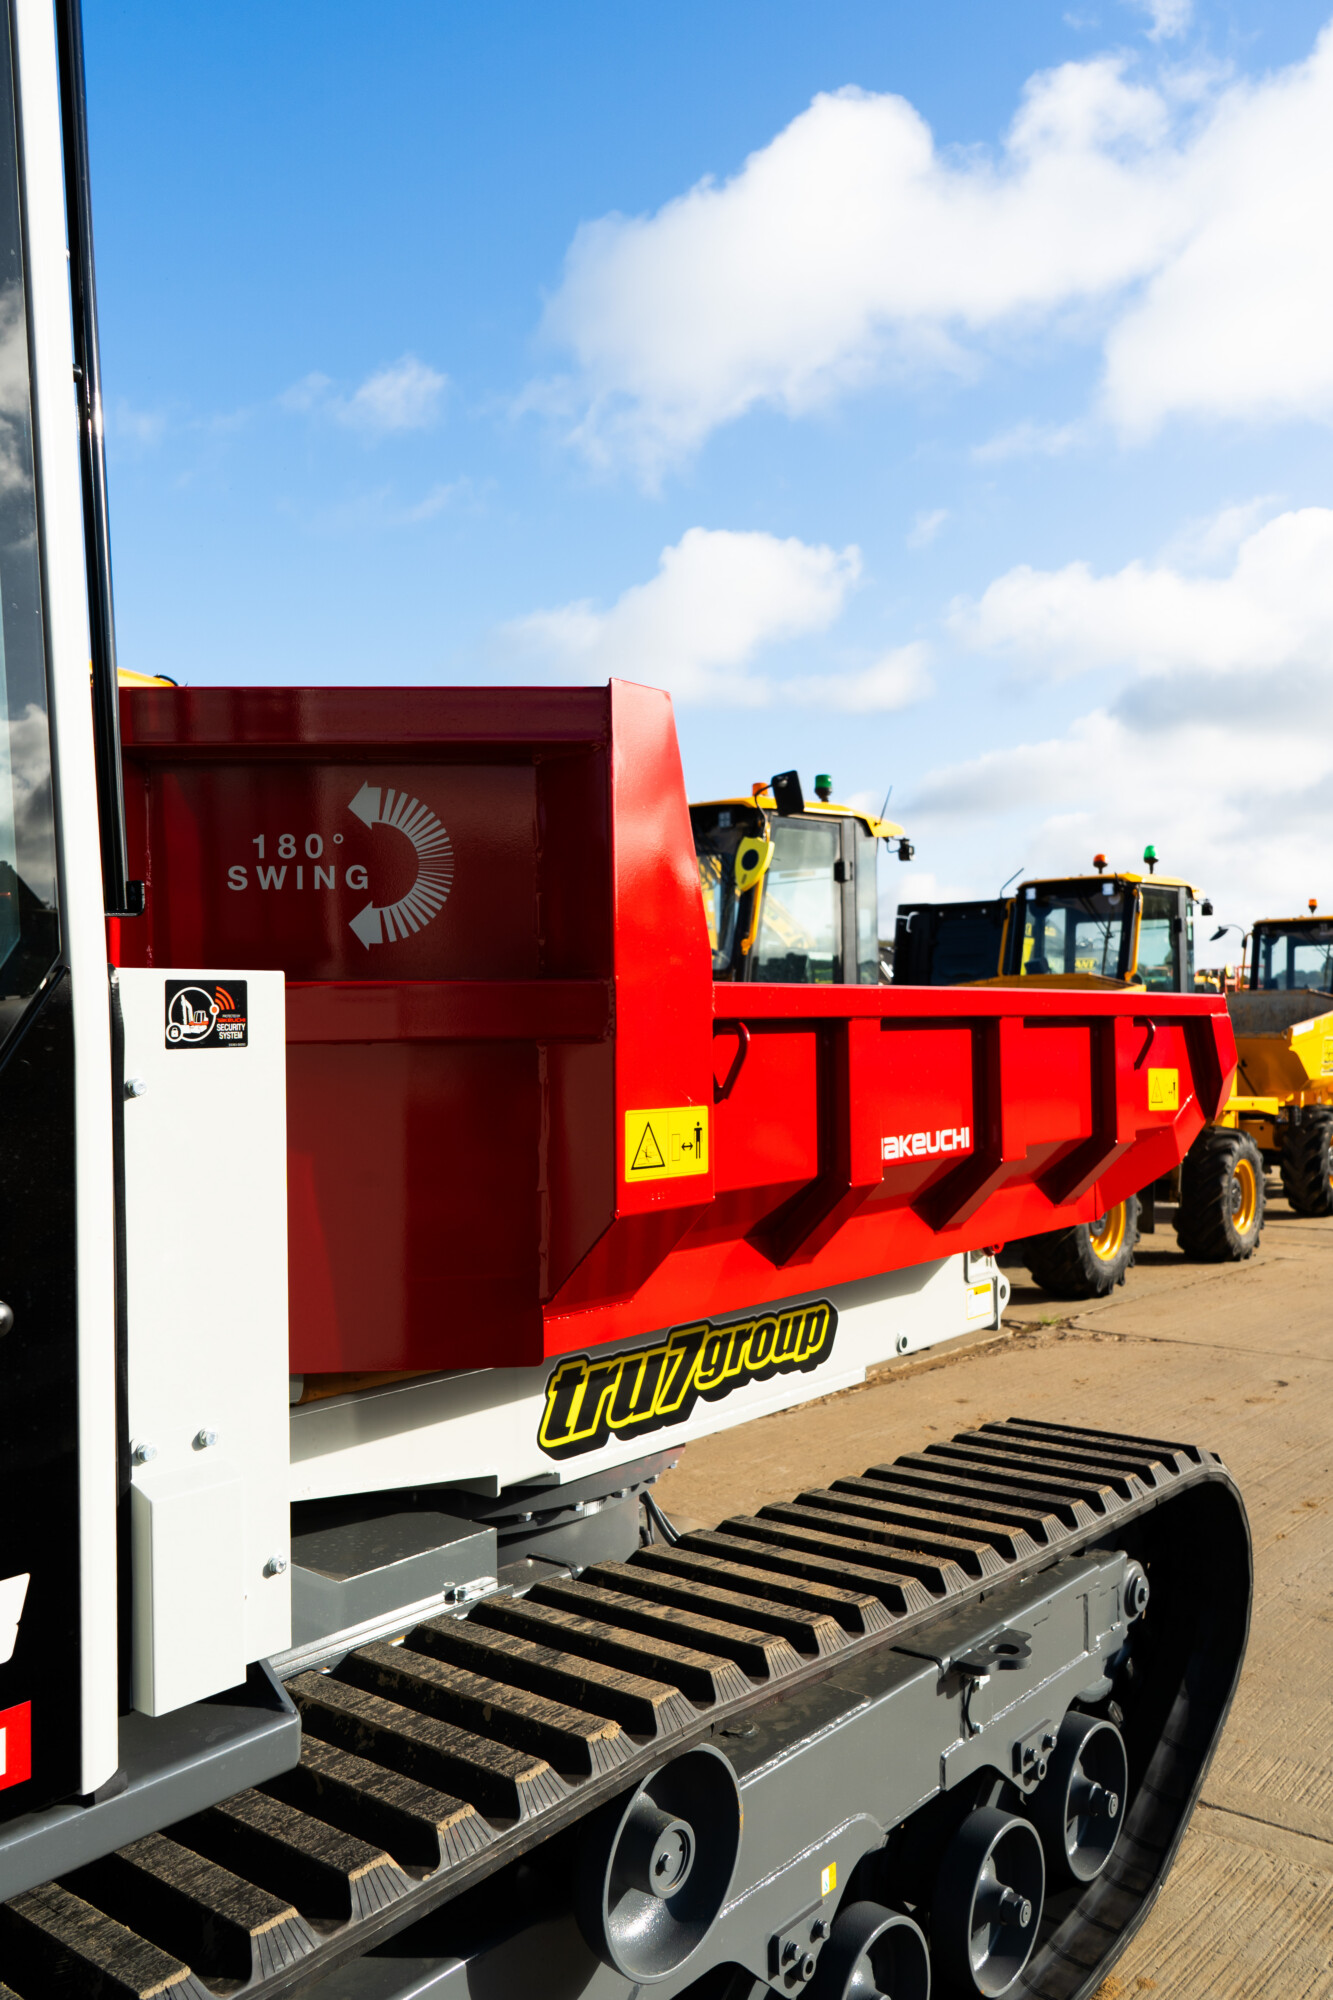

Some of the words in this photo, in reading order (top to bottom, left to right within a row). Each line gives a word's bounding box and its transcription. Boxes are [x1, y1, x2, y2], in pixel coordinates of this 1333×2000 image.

[252, 833, 344, 859] 180°
[227, 865, 368, 891] SWING
[216, 1023, 246, 1031] SECURITY
[218, 1031, 243, 1039] SYSTEM
[540, 1303, 831, 1448] tru7group
